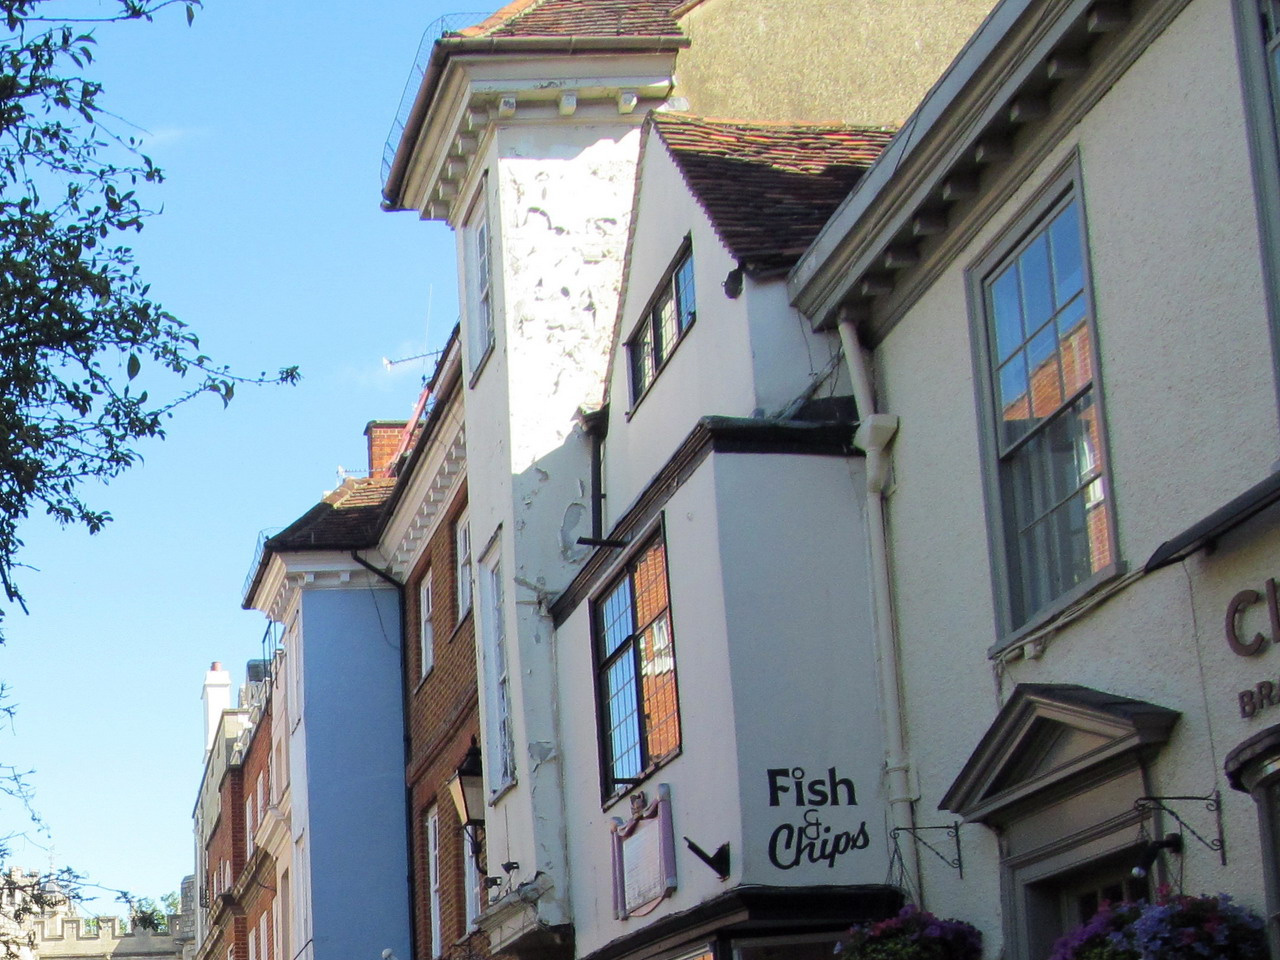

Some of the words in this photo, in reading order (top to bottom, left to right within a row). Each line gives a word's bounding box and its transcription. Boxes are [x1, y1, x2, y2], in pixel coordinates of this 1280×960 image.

[766, 766, 858, 807] Fish
[803, 808, 822, 841] &
[768, 821, 870, 870] Chips
